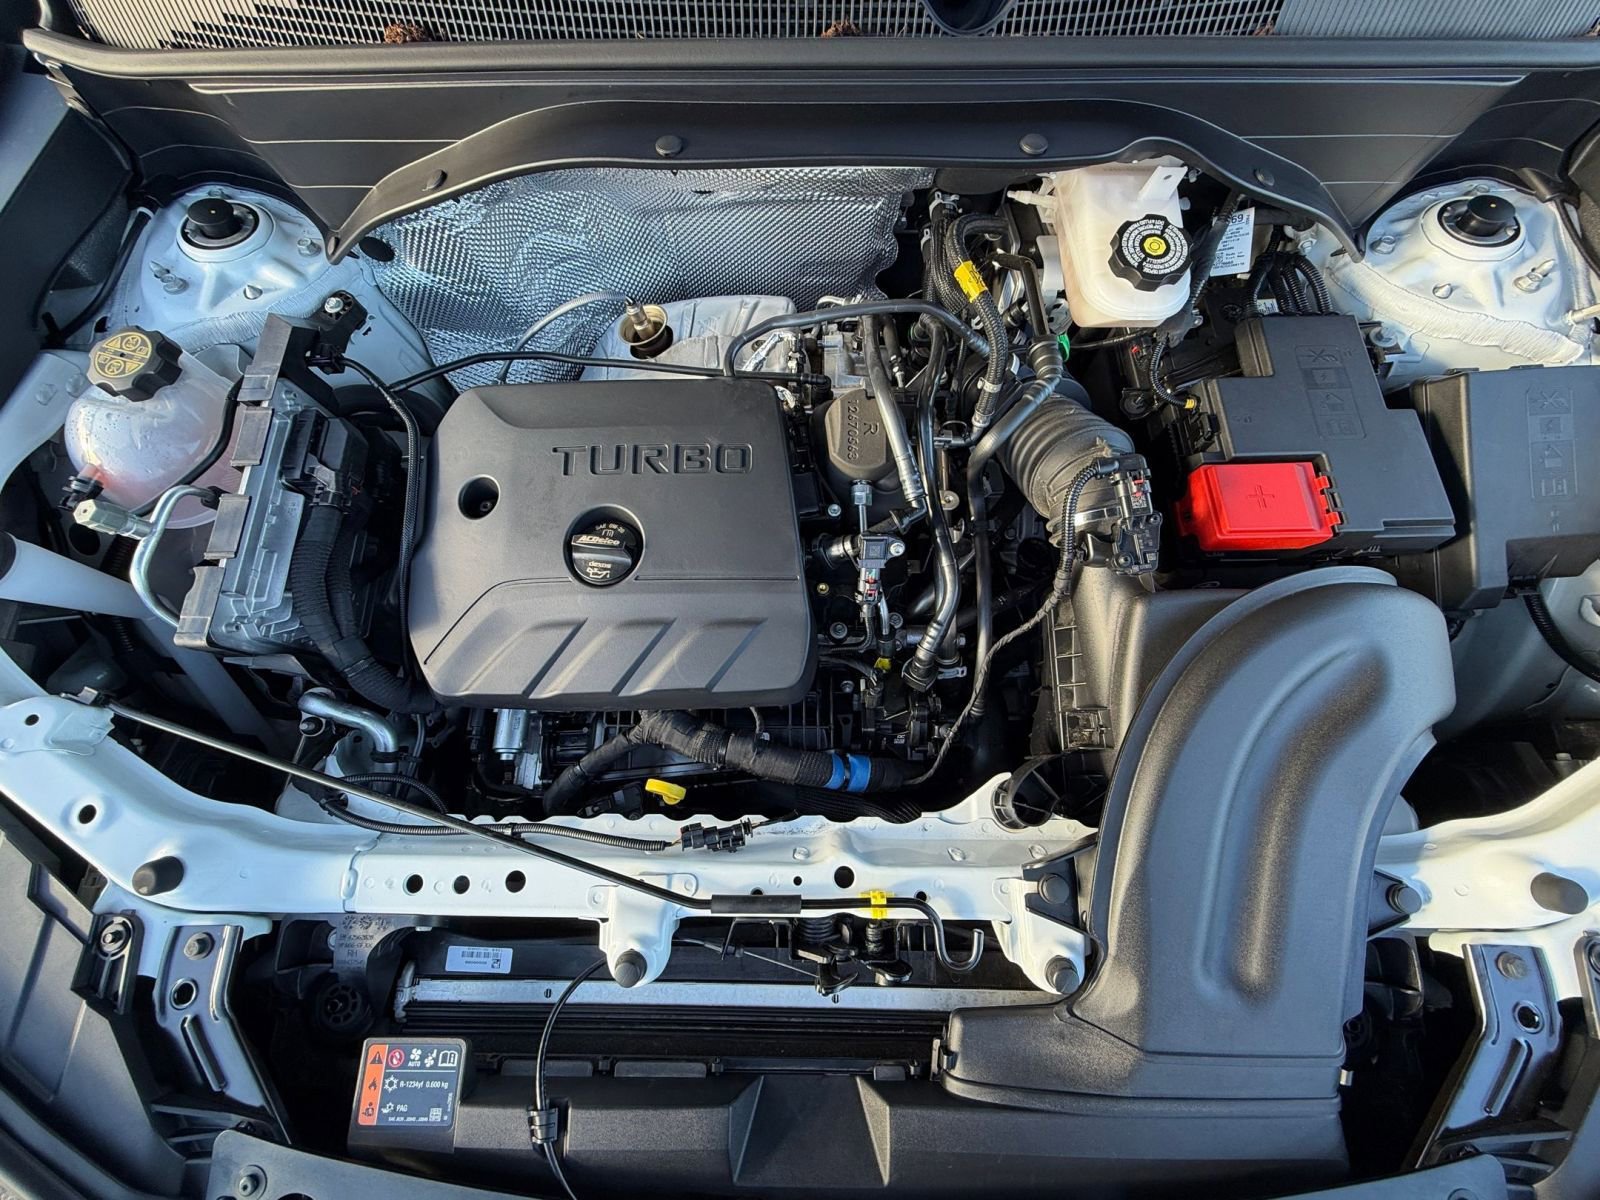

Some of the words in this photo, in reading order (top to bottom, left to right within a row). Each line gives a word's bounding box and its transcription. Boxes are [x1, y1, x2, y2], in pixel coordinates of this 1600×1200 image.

[863, 422, 879, 435] R
[552, 443, 753, 476] TURBO
[576, 535, 620, 546] ACDelco
[400, 1080, 424, 1089] R-1234yf
[425, 1080, 441, 1088] 0.600
[441, 1080, 449, 1089] kg
[396, 1104, 408, 1112] PAG
